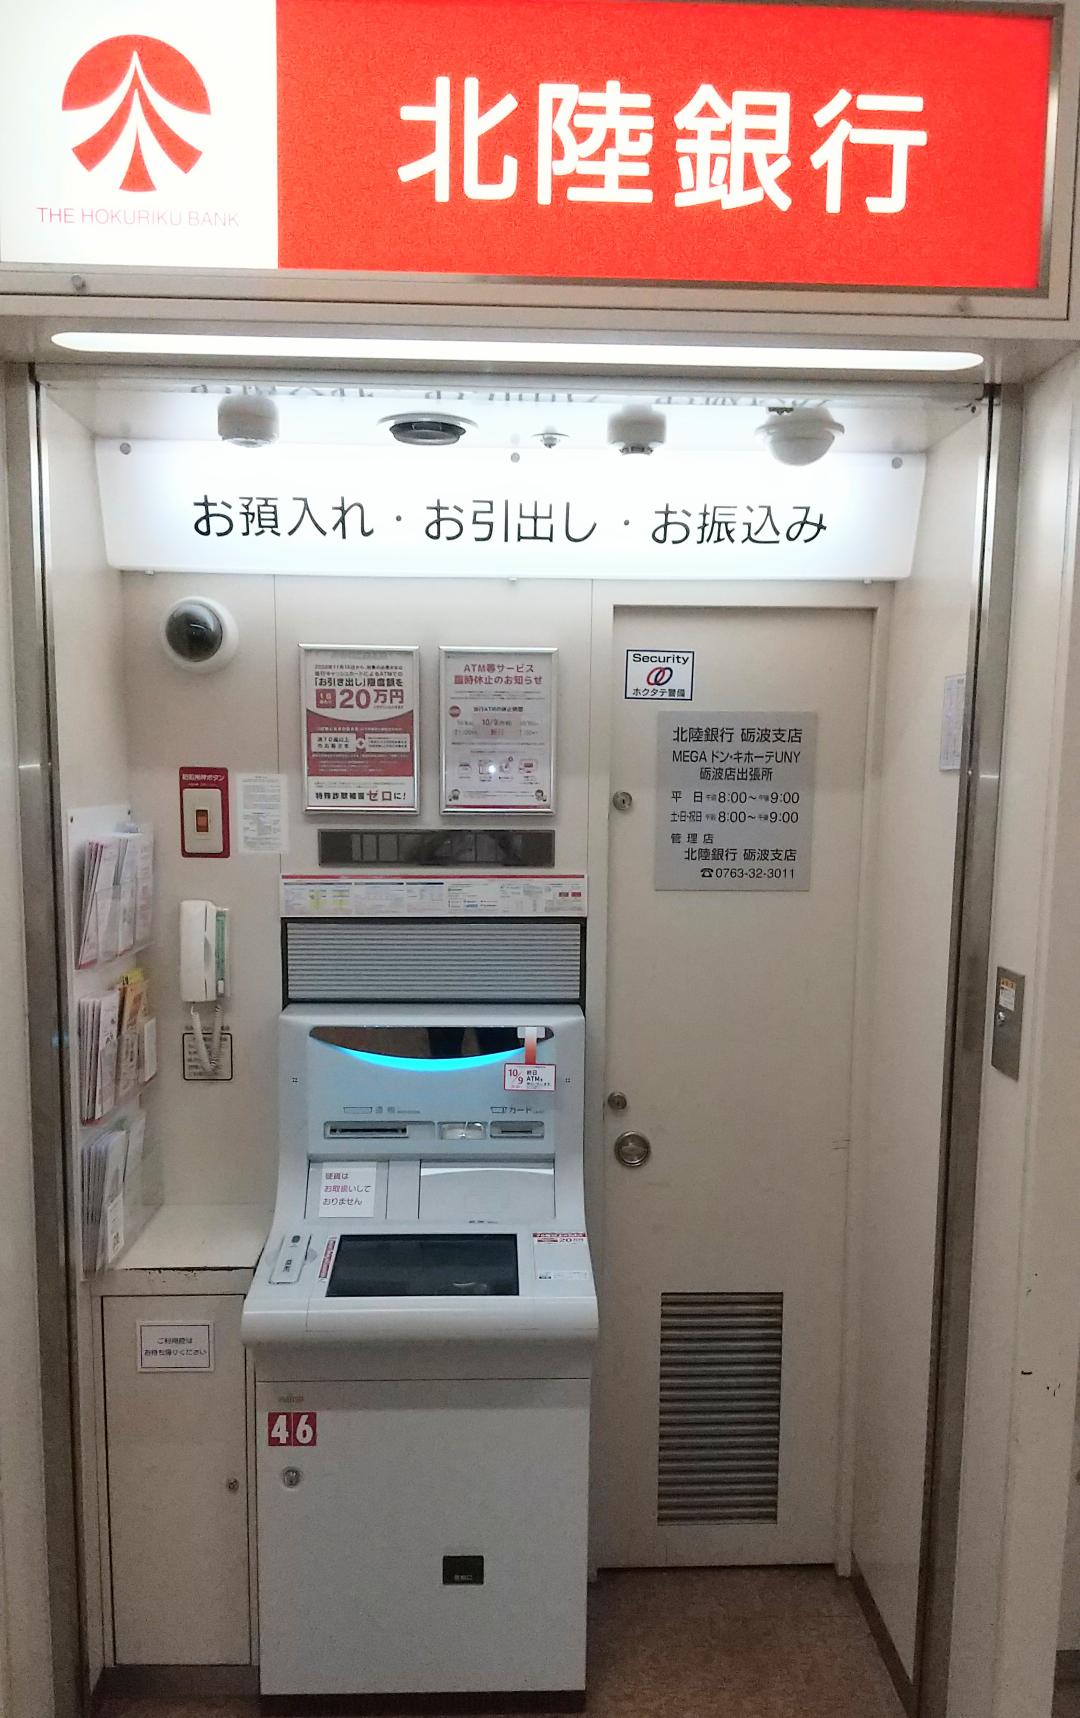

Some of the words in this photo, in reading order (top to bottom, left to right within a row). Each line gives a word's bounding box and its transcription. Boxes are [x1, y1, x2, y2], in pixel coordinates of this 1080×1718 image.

[397, 75, 928, 213] 北陸銀行
[36, 207, 75, 223] THE
[81, 208, 182, 225] HOKURIKU
[188, 210, 240, 227] BANK
[632, 653, 690, 665] Security
[339, 688, 404, 709] 20万円
[632, 687, 686, 698] ホクタテ警備
[672, 727, 734, 743] 北陸銀行
[740, 728, 803, 743] 砺波支店
[672, 751, 707, 763] MEGA
[711, 751, 801, 764] ドン・キホーテUNY
[699, 767, 773, 781] 砺波店出張所
[670, 833, 714, 844] 管理店
[684, 848, 737, 861] 北陸銀行
[742, 849, 797, 862] 砺波支店
[715, 867, 795, 878] 0763-32-3011
[322, 1197, 363, 1206] おりません
[270, 1414, 314, 1444] 46
